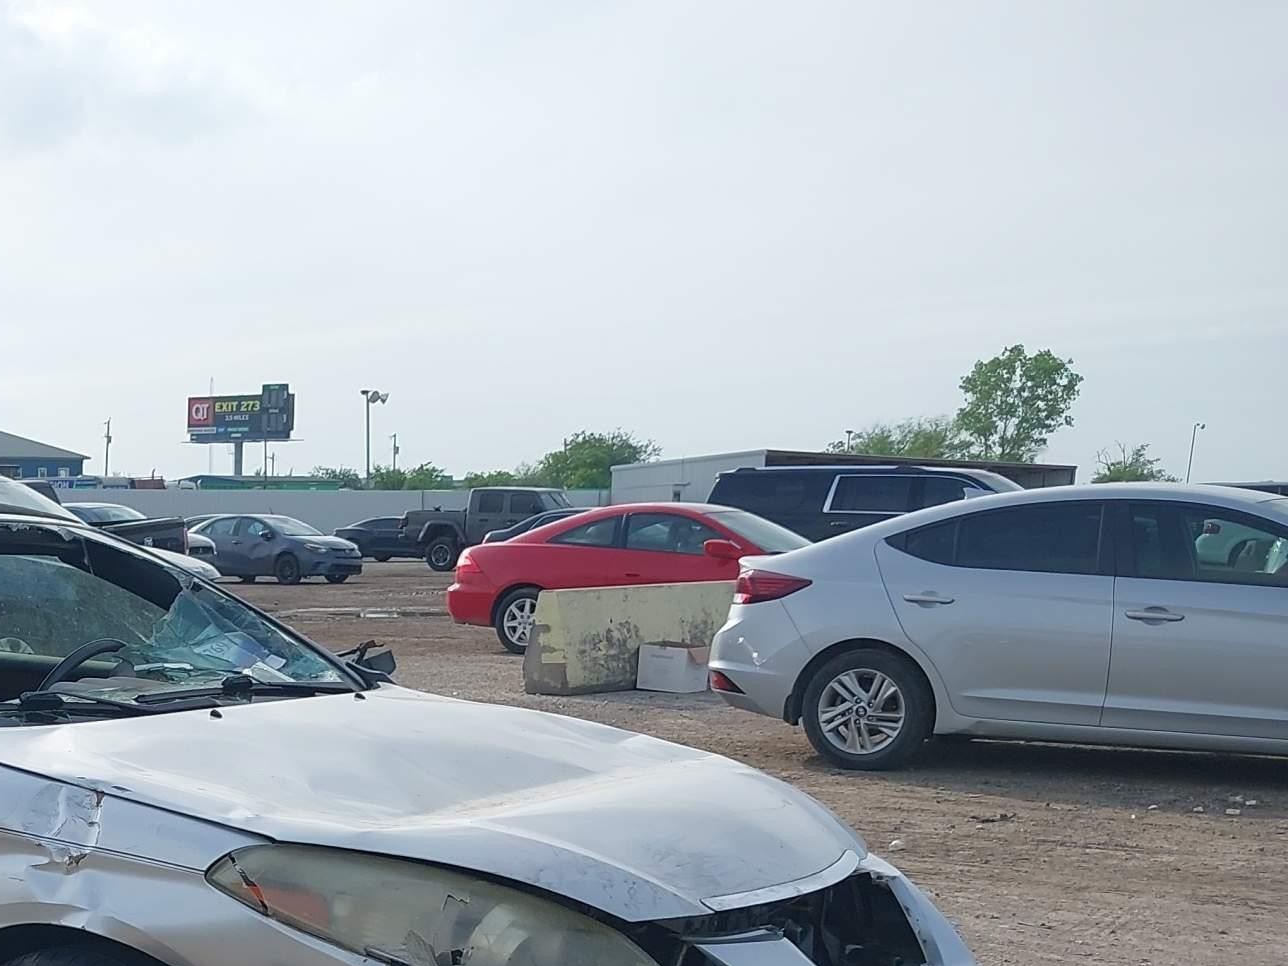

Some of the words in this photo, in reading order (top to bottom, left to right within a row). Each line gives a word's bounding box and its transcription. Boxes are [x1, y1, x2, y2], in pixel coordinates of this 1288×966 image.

[192, 403, 210, 421] QT
[215, 401, 238, 413] EXIT
[240, 400, 260, 412] 273
